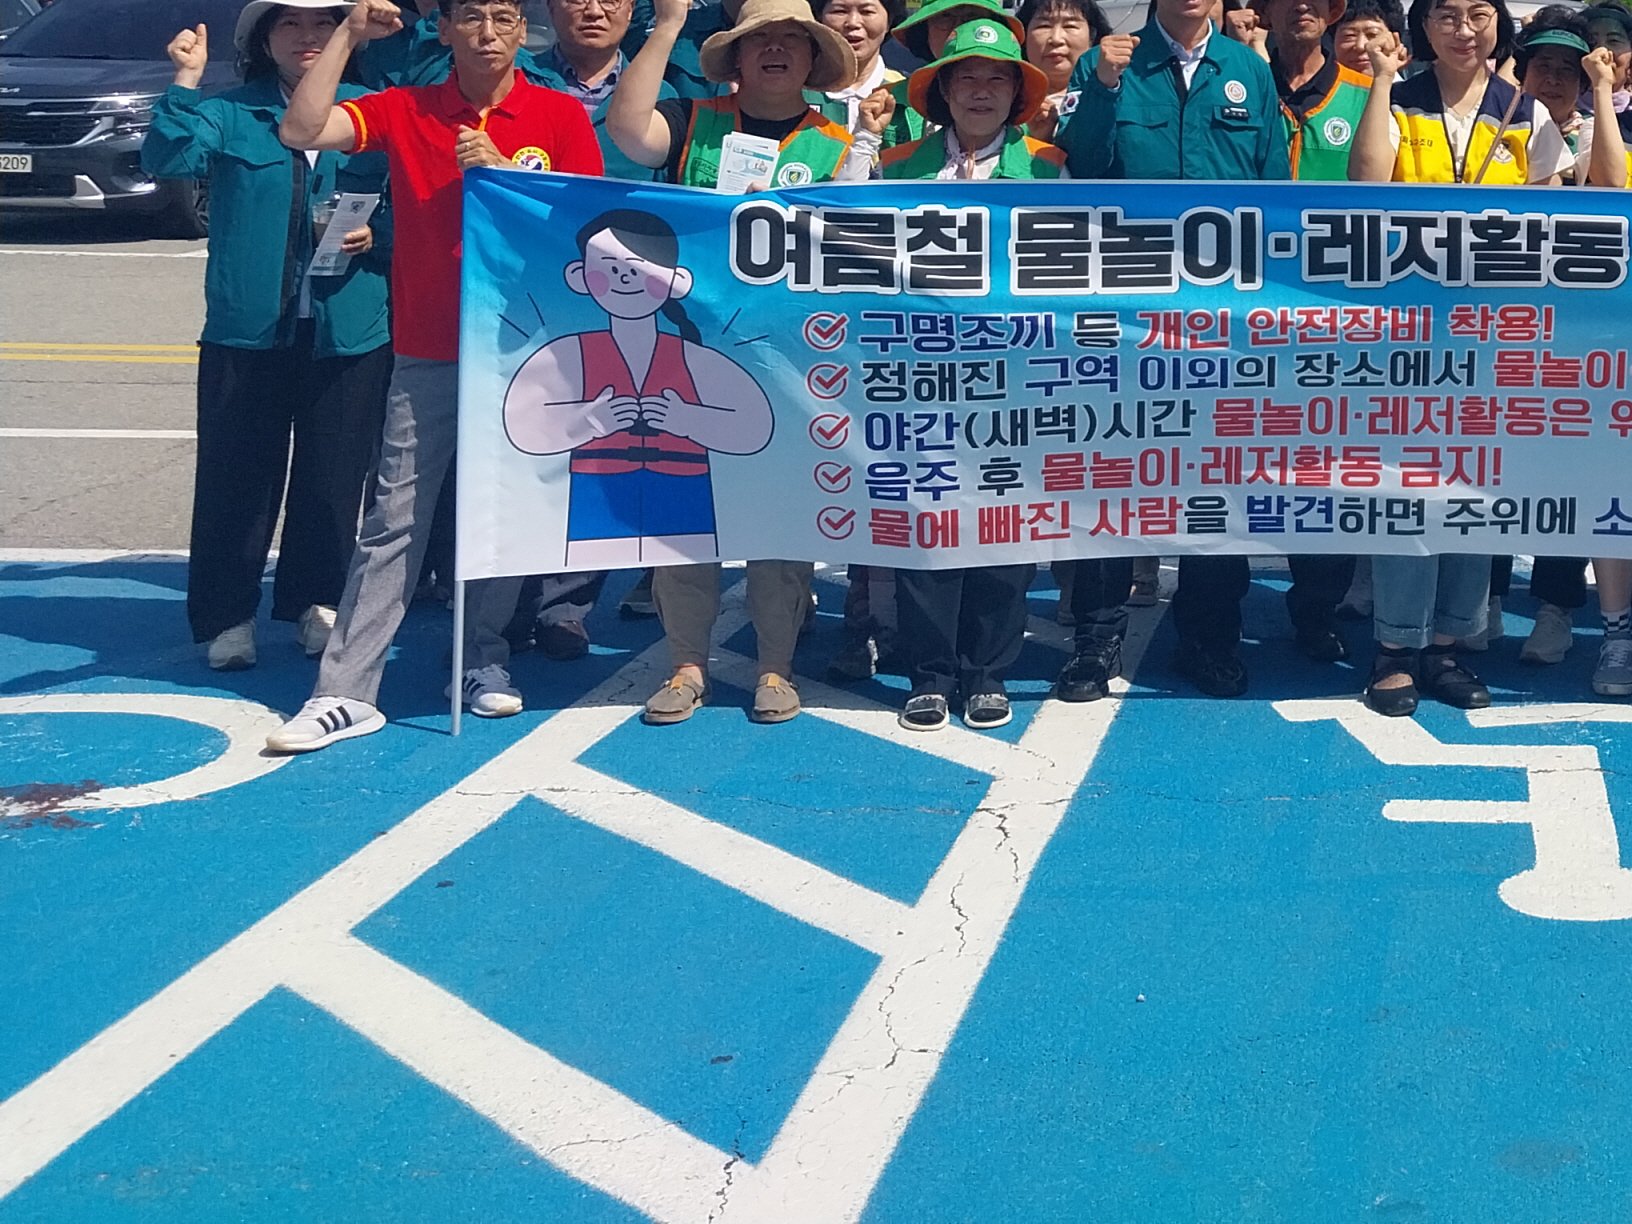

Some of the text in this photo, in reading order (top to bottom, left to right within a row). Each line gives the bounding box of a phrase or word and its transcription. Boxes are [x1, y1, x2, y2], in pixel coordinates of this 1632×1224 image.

[0, 157, 29, 170] 209
[732, 201, 990, 295] 여름철
[1010, 205, 1630, 295] 물놀이·레저활동
[859, 304, 1554, 351] 구명조끼 등 개인 안전장비 착용!
[862, 361, 1008, 403] 정해진
[1024, 357, 1118, 397] 구역
[1138, 354, 1277, 393] 이외의
[1294, 350, 1477, 389] 장소에서
[864, 399, 1196, 453] 야간(새벽)시간
[1212, 396, 1593, 439] 물놀이·레저활동은
[864, 445, 1502, 501] 음주 후 물놀이·레저활동 금지!
[868, 506, 960, 550] 물에
[977, 501, 1072, 545] 빠진
[1089, 493, 1228, 538] 사람을
[1245, 493, 1426, 537] 발견하면
[1442, 496, 1577, 537] 주위에
